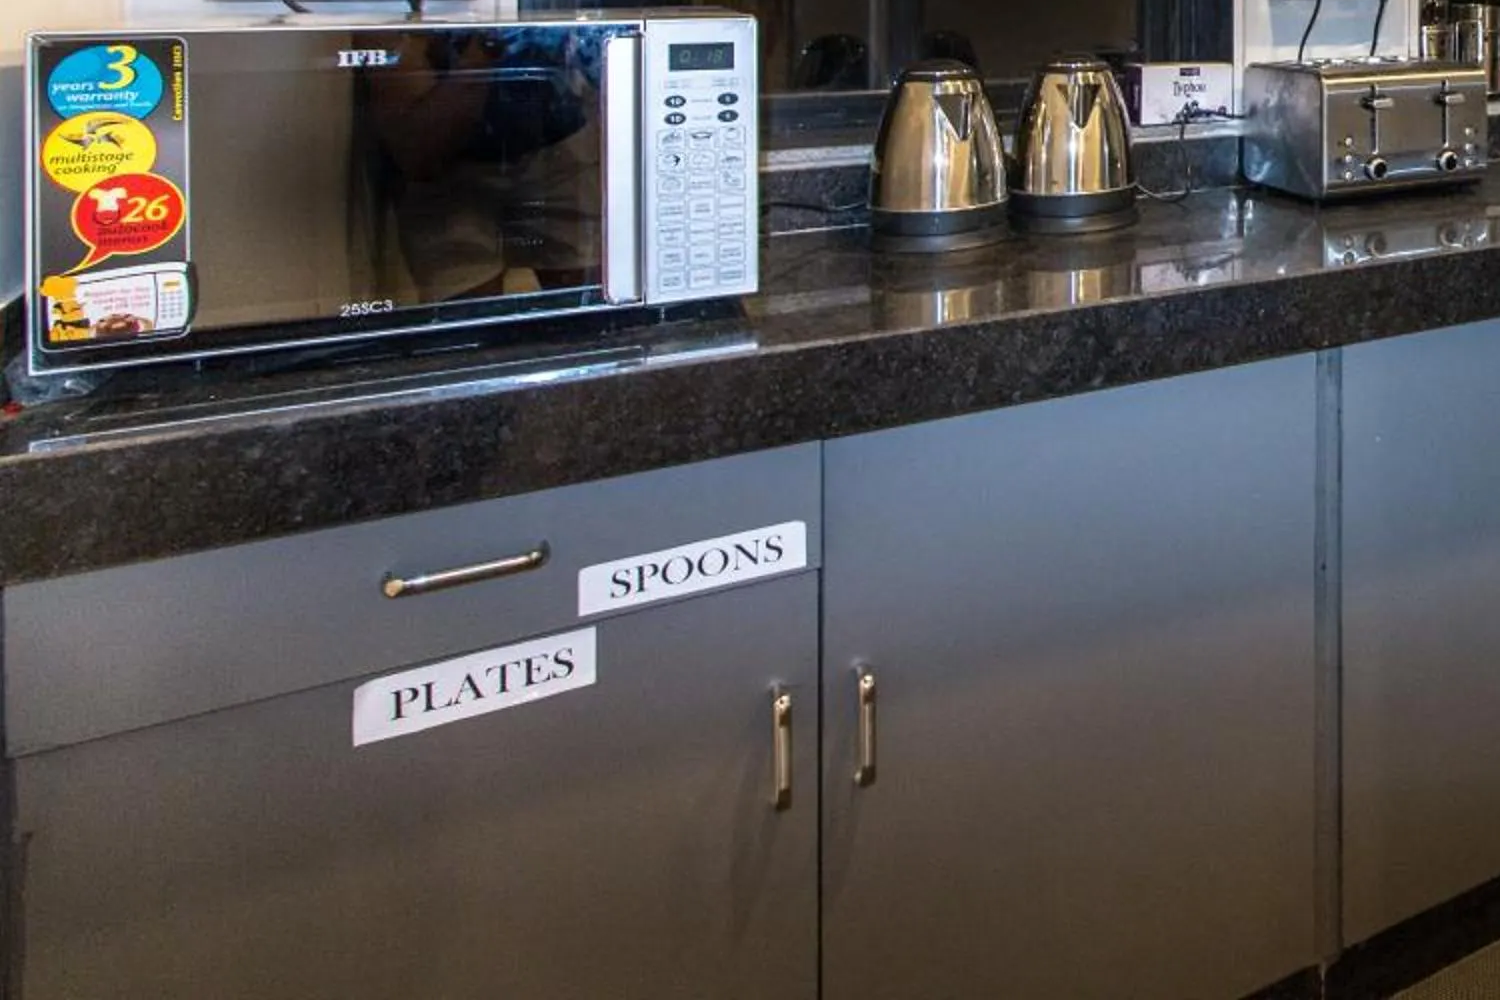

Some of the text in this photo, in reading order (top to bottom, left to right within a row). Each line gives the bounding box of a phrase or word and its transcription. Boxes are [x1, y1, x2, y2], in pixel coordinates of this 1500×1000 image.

[98, 45, 138, 90] 3
[337, 48, 387, 68] IFB
[52, 81, 94, 96] years
[65, 90, 139, 104] warranty
[49, 150, 134, 166] multistage
[54, 162, 118, 176] cooking
[120, 194, 171, 224] 26
[340, 299, 393, 317] 25SC3
[610, 534, 785, 601] SPOONS
[389, 647, 576, 721] PLATES
